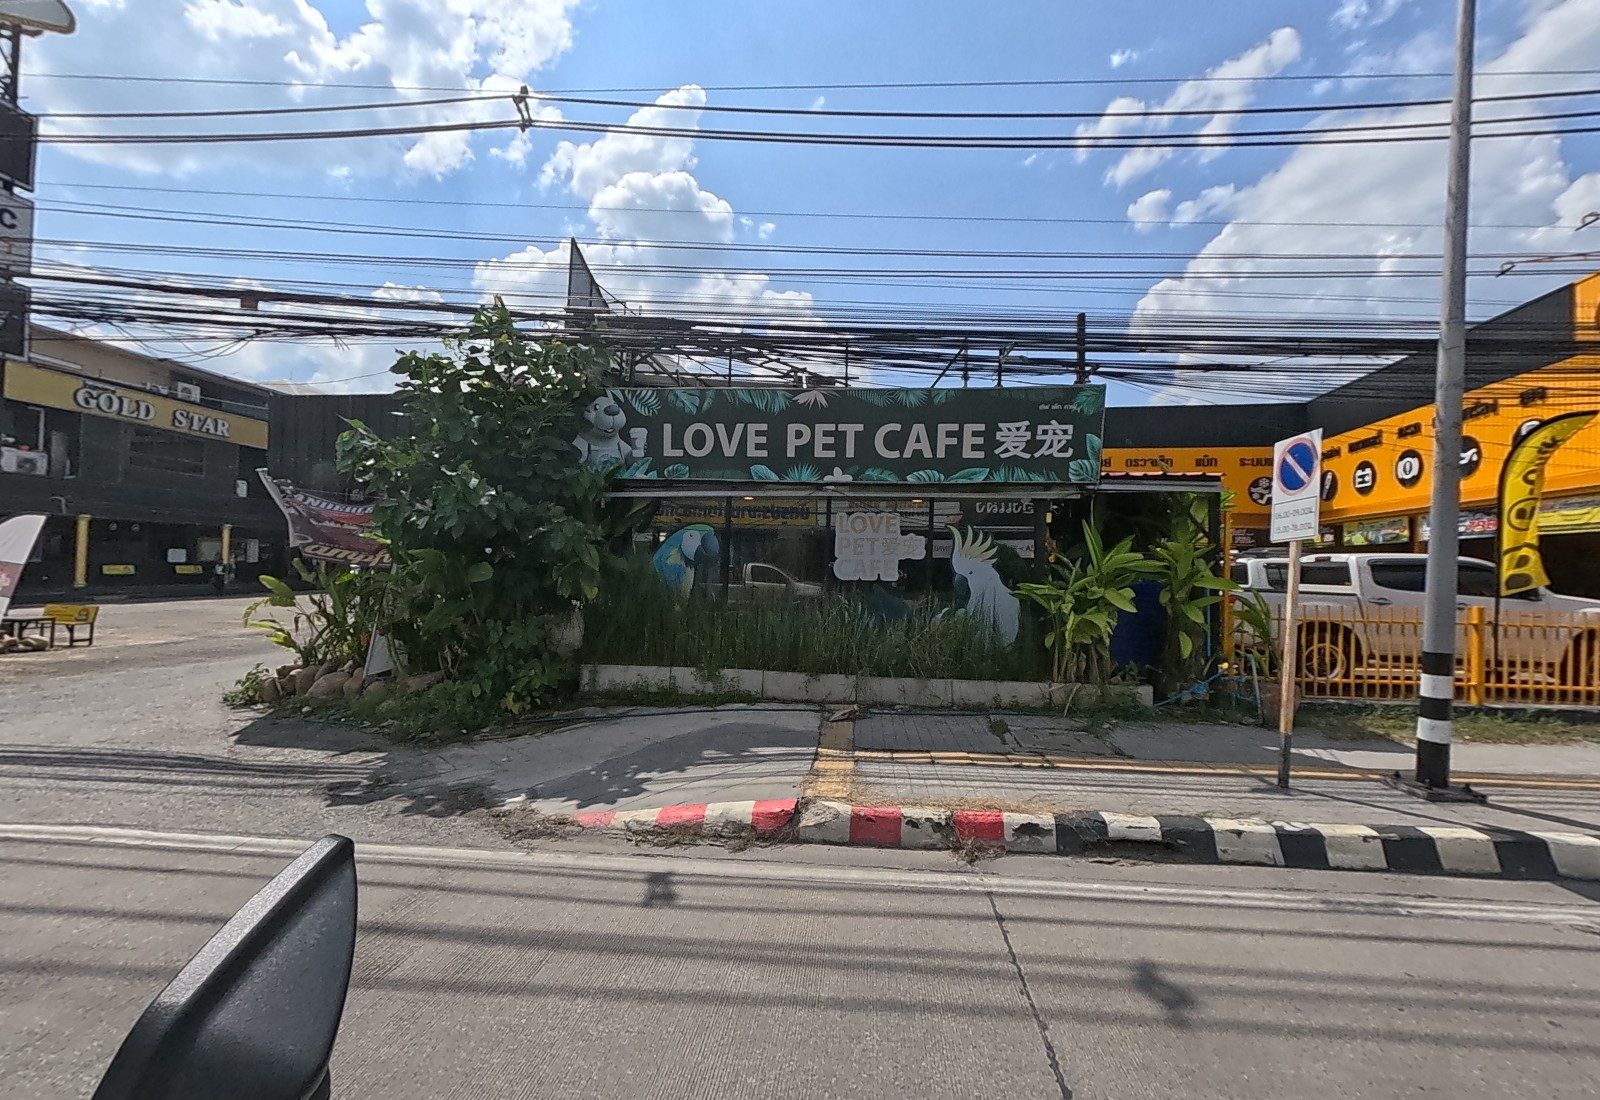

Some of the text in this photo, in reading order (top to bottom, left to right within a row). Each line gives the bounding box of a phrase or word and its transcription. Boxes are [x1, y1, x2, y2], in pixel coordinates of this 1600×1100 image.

[74, 387, 230, 437] GOLD STAR
[662, 419, 1074, 460] LOVE PET CAFE 爱宠
[838, 515, 897, 534] LOVE
[838, 537, 880, 555] PET
